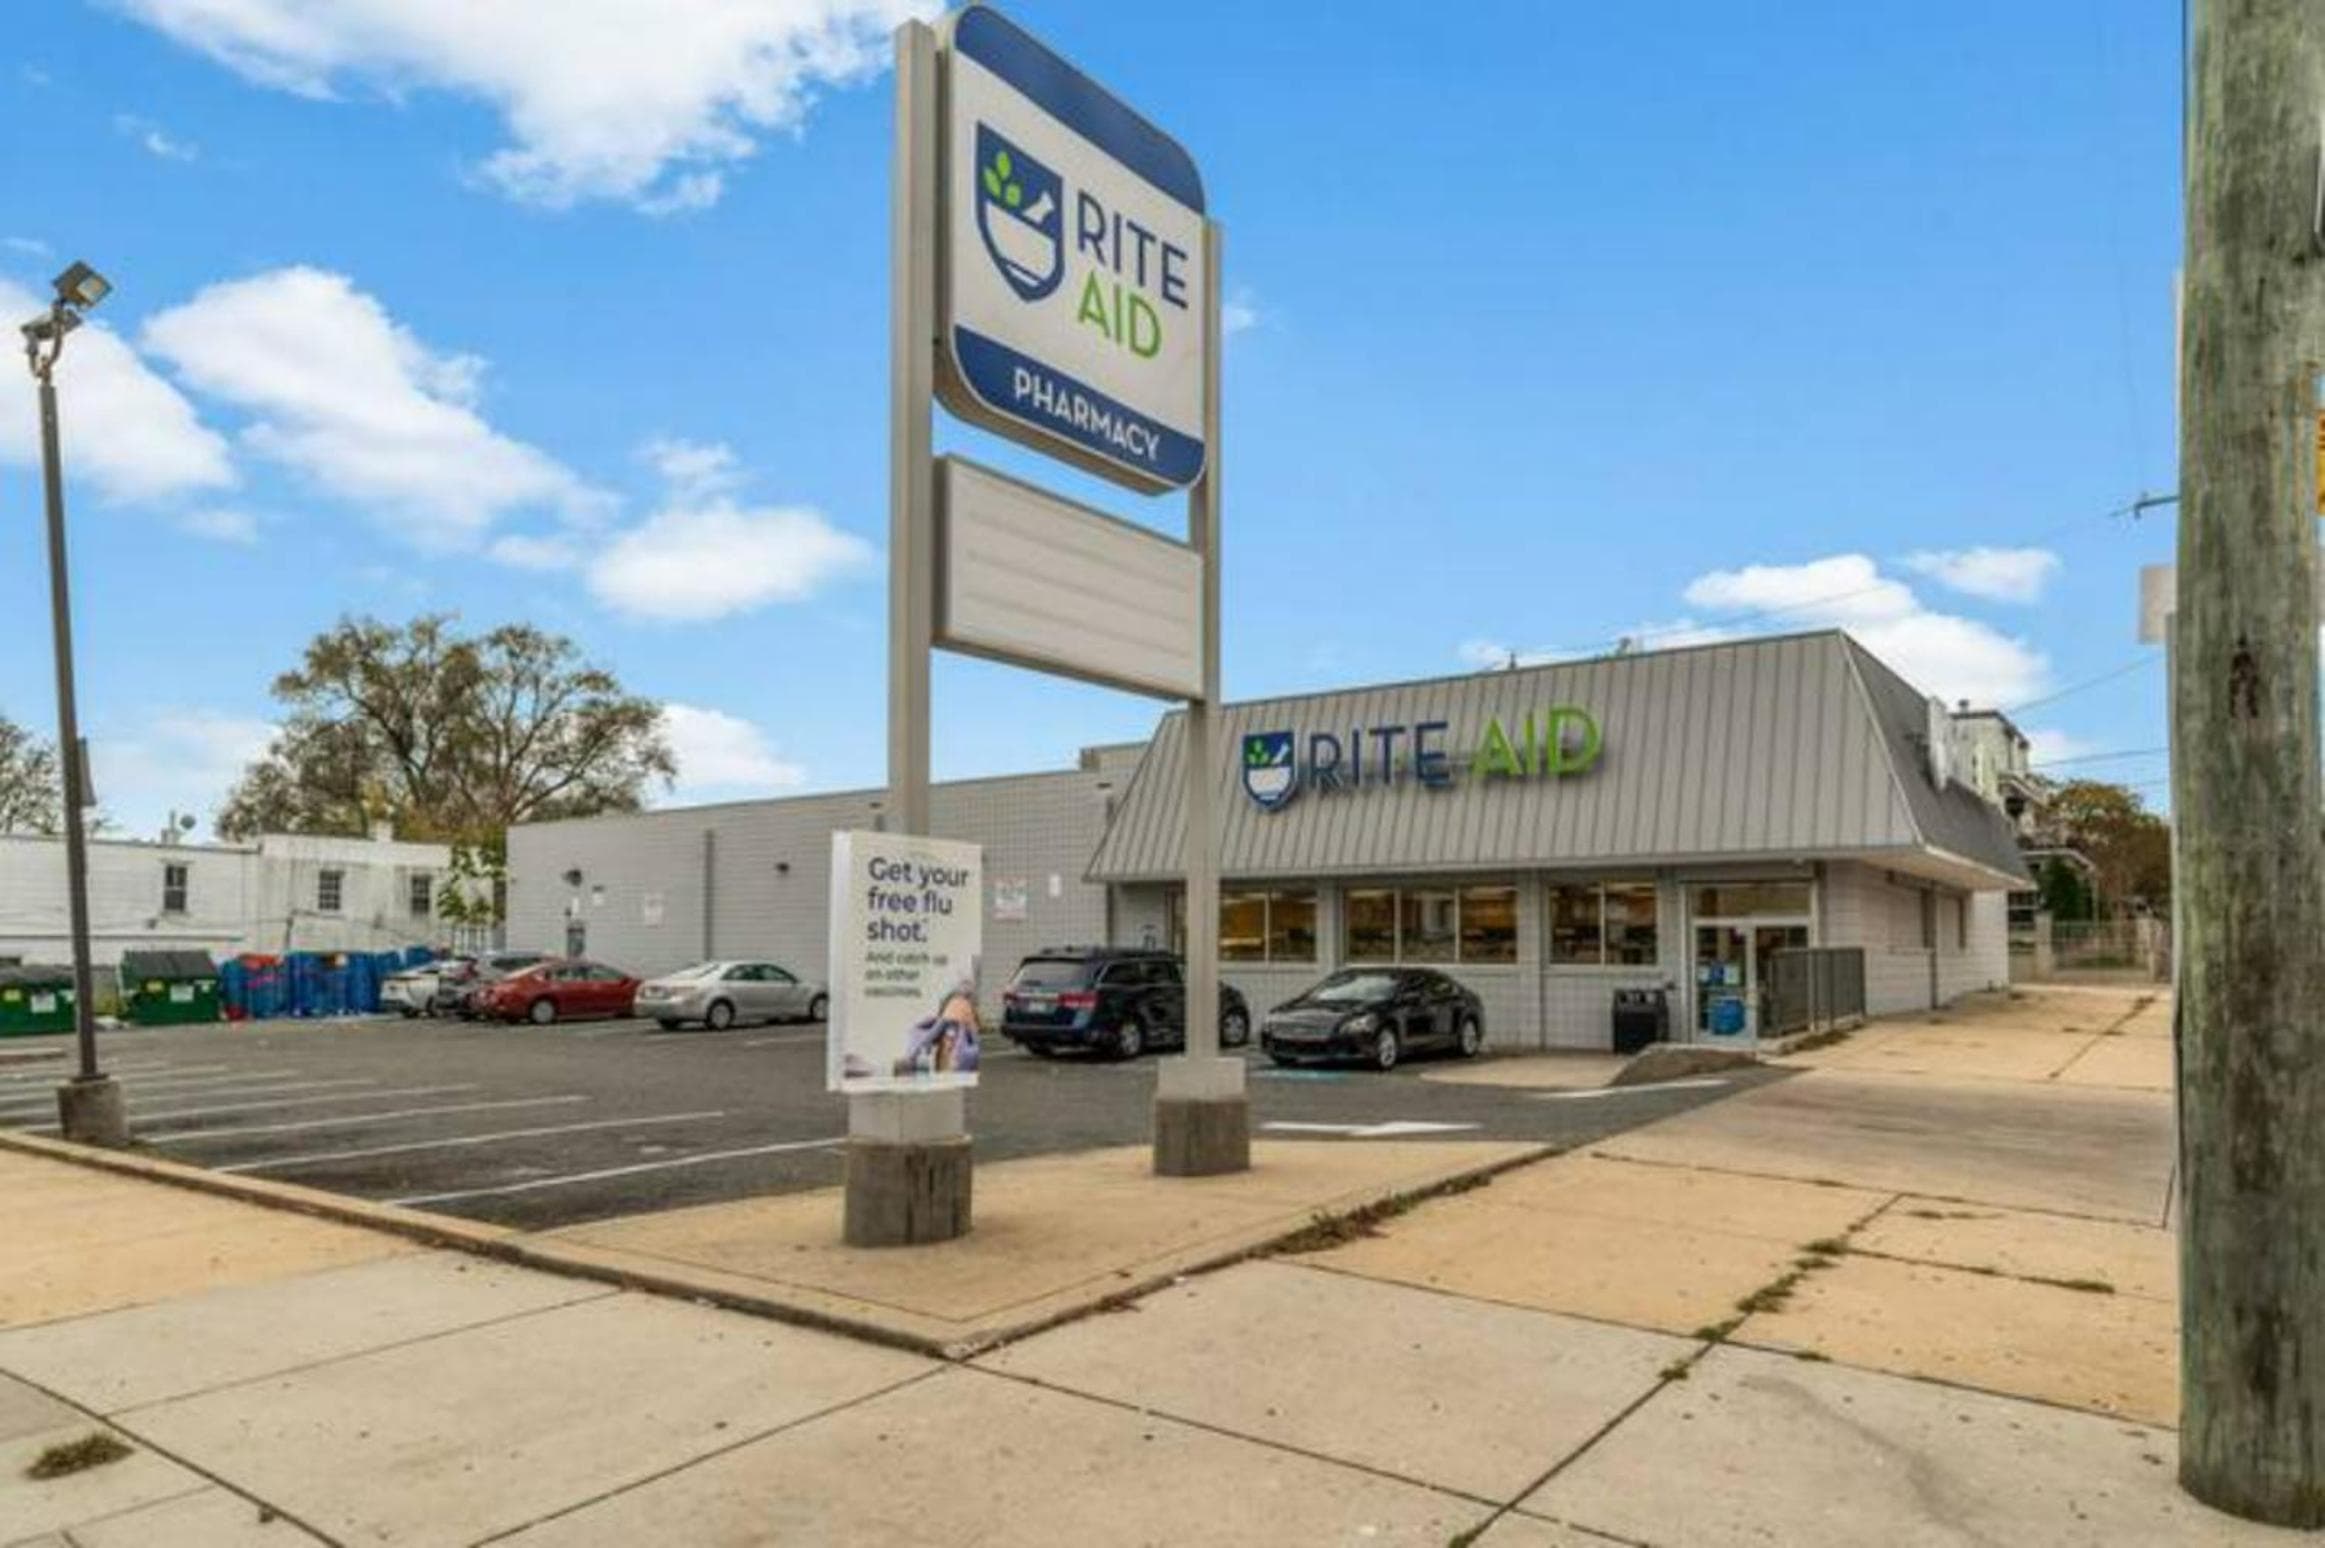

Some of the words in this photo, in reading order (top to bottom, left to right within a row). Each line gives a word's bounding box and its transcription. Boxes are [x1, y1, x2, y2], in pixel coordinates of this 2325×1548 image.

[1077, 189, 1189, 310] RITE
[1077, 270, 1163, 359] AID
[1013, 367, 1161, 461] PHARMACY
[1309, 720, 1450, 791] RITE
[1472, 706, 1602, 776] AID
[867, 857, 913, 883] Get
[919, 864, 969, 890] your
[868, 886, 918, 913] free
[923, 890, 953, 915] flu
